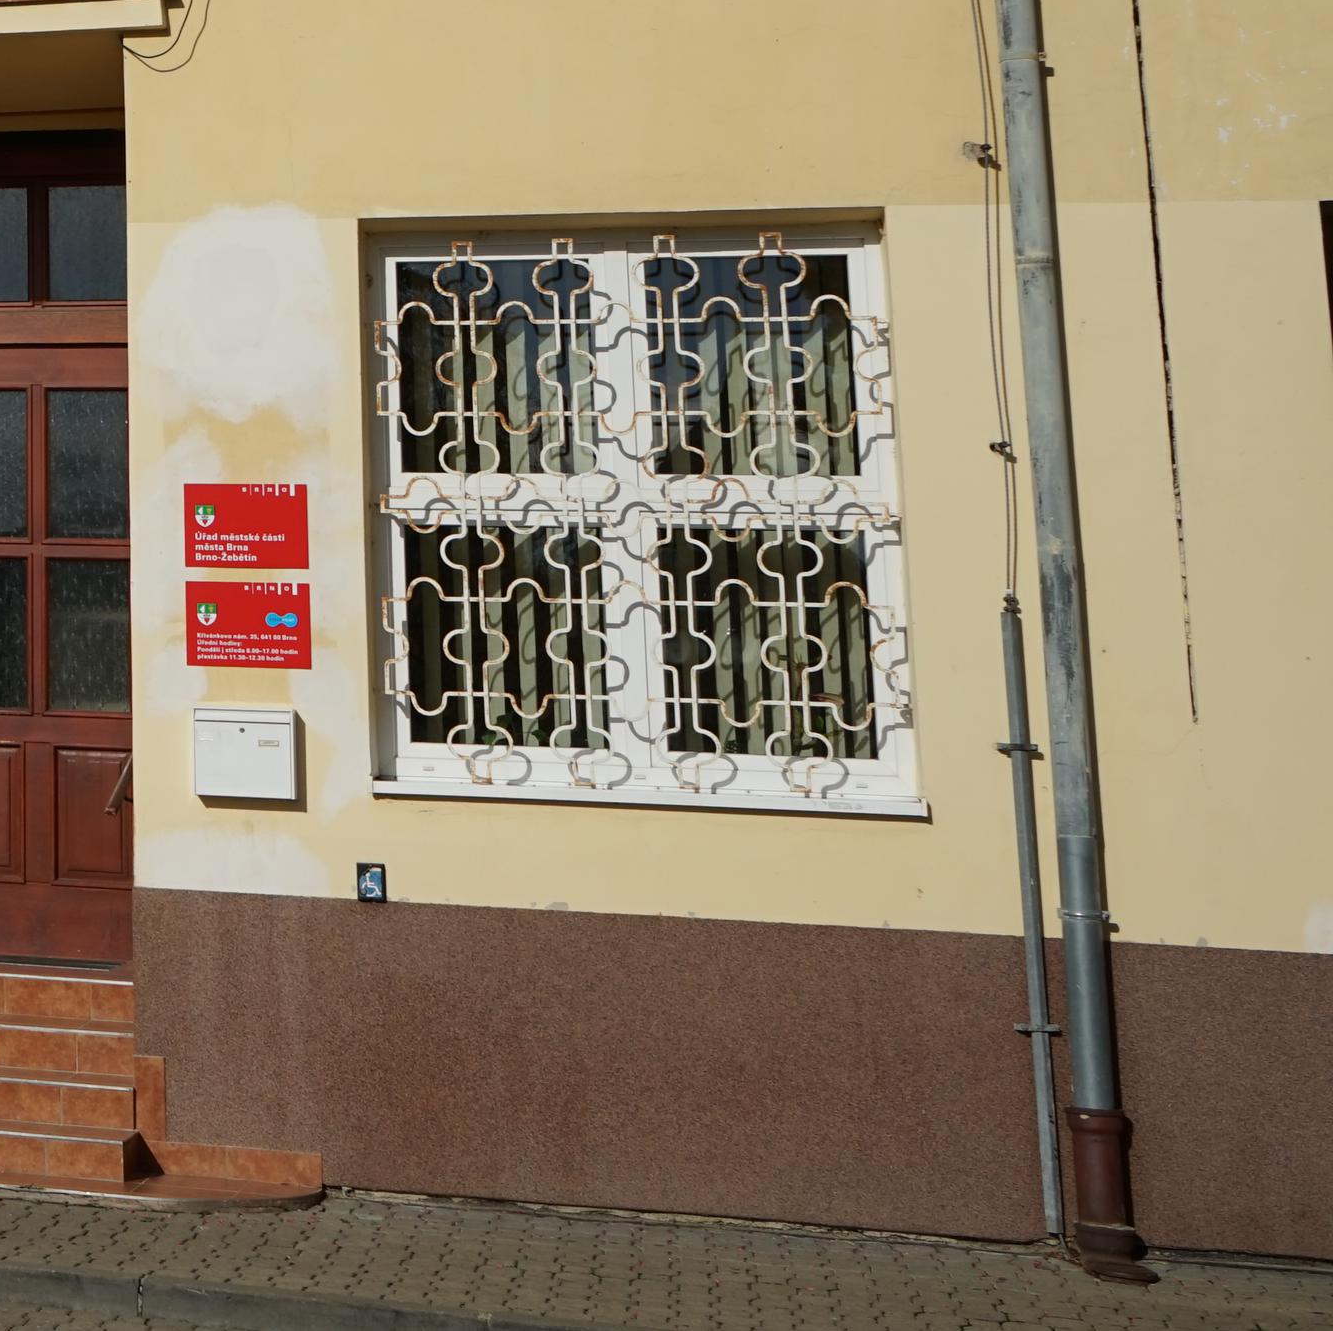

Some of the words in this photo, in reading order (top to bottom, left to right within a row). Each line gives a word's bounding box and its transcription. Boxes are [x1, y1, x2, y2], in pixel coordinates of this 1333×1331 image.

[195, 531, 218, 541] Úřad
[220, 533, 260, 542] městské
[262, 533, 285, 542] části
[195, 542, 224, 551] města
[226, 543, 249, 552] Brna
[195, 551, 258, 562] Brno-Žebětín
